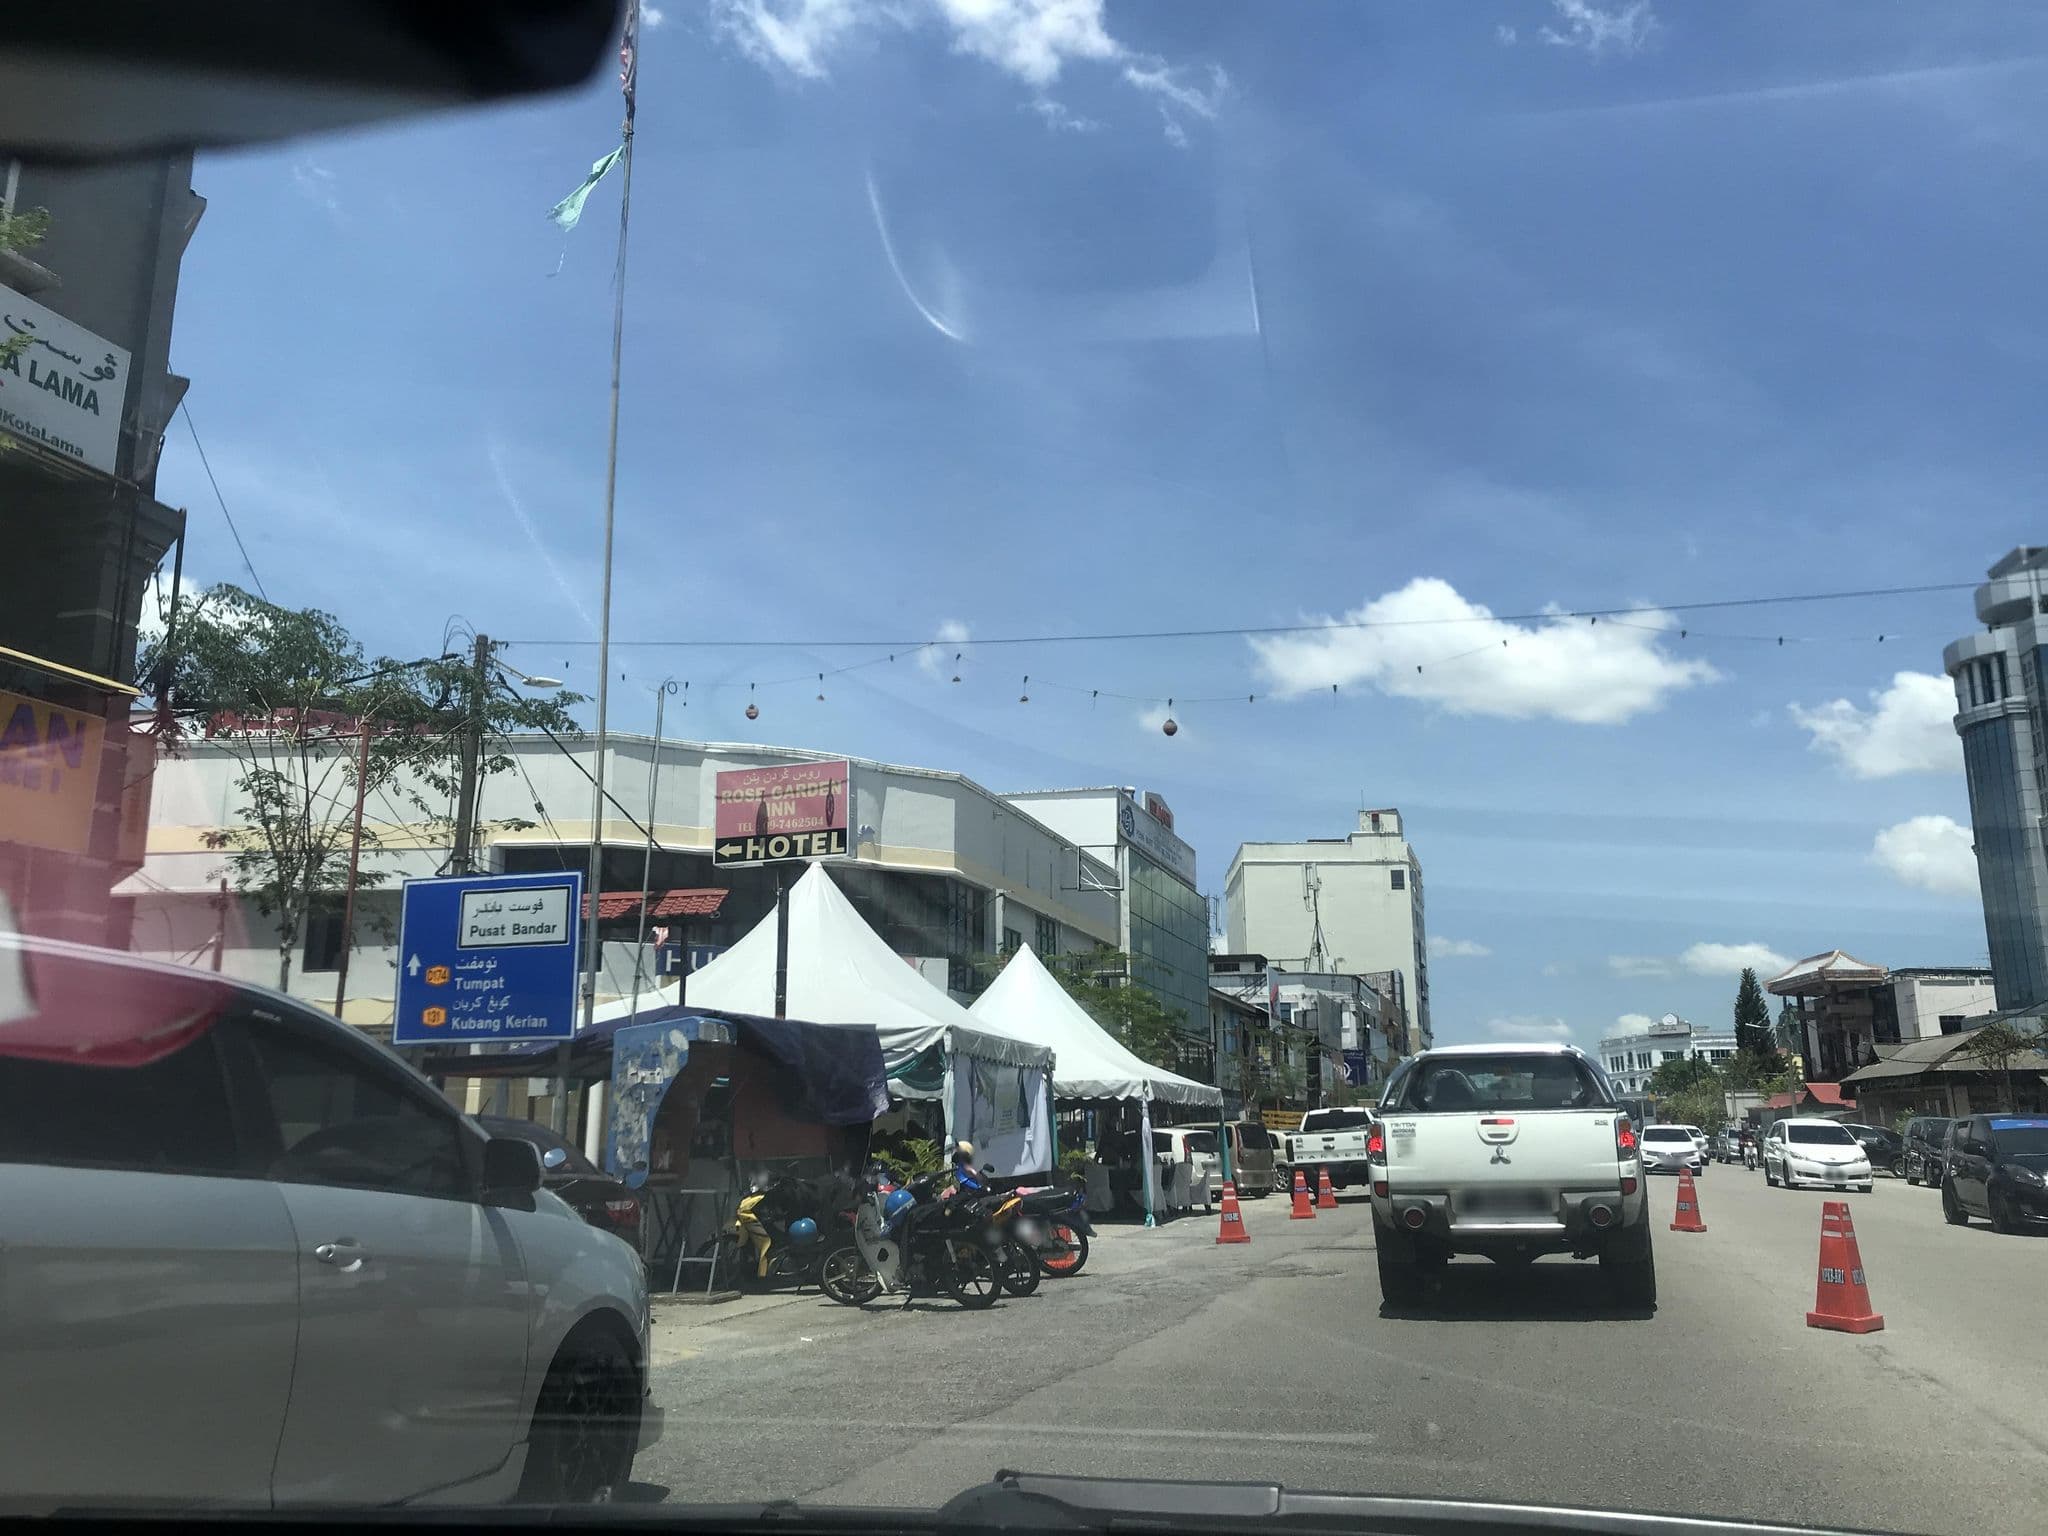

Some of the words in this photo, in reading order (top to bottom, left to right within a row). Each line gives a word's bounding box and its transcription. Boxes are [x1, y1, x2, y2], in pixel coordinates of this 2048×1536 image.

[29, 359, 100, 416] LAMA
[721, 788, 766, 804] ROSE
[771, 781, 842, 801] GARDEN
[746, 832, 845, 860] HOTEL
[470, 924, 506, 937] Pusat
[512, 922, 557, 935] Bandar
[454, 976, 505, 991] Tumpat
[451, 1016, 501, 1032] Kubang
[505, 1014, 548, 1029] Kerian
